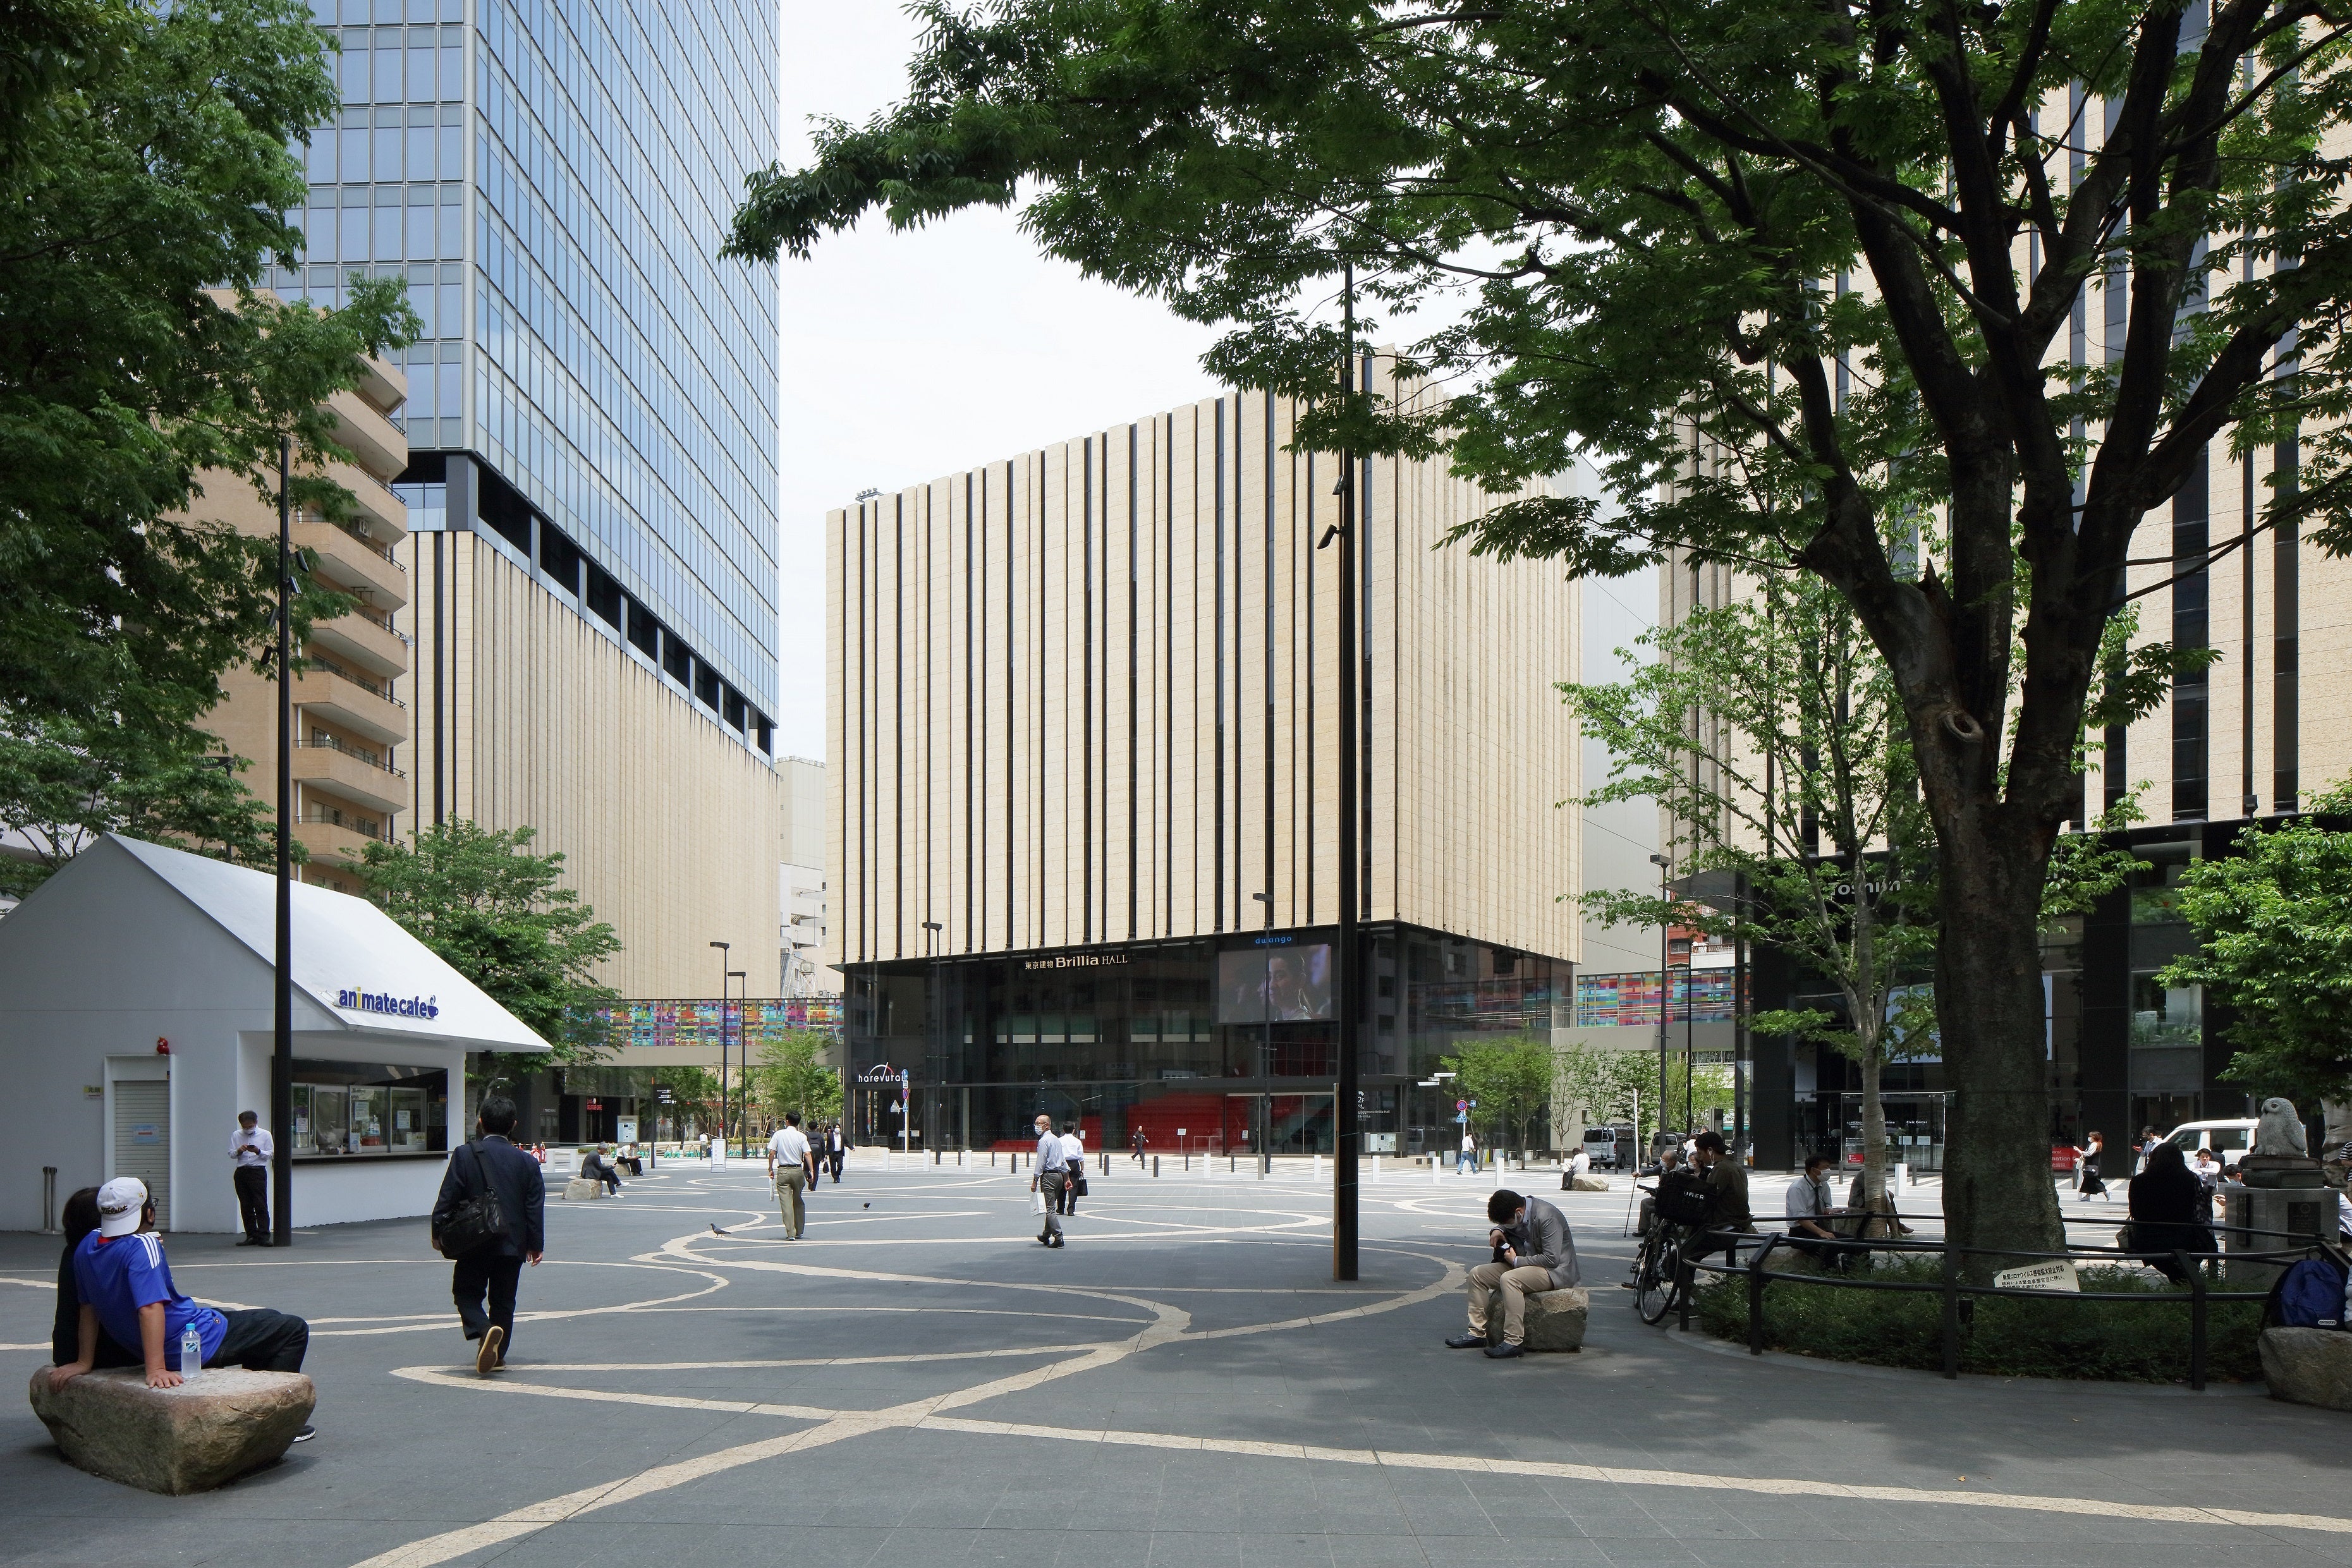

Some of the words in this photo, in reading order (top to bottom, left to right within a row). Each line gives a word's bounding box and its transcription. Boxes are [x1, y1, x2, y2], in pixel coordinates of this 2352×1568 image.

[1025, 960, 1054, 969] 東京建物
[1056, 956, 1099, 968] Brillia
[1102, 954, 1128, 965] HALL
[339, 986, 398, 1013] animate
[399, 995, 427, 1017] cafe
